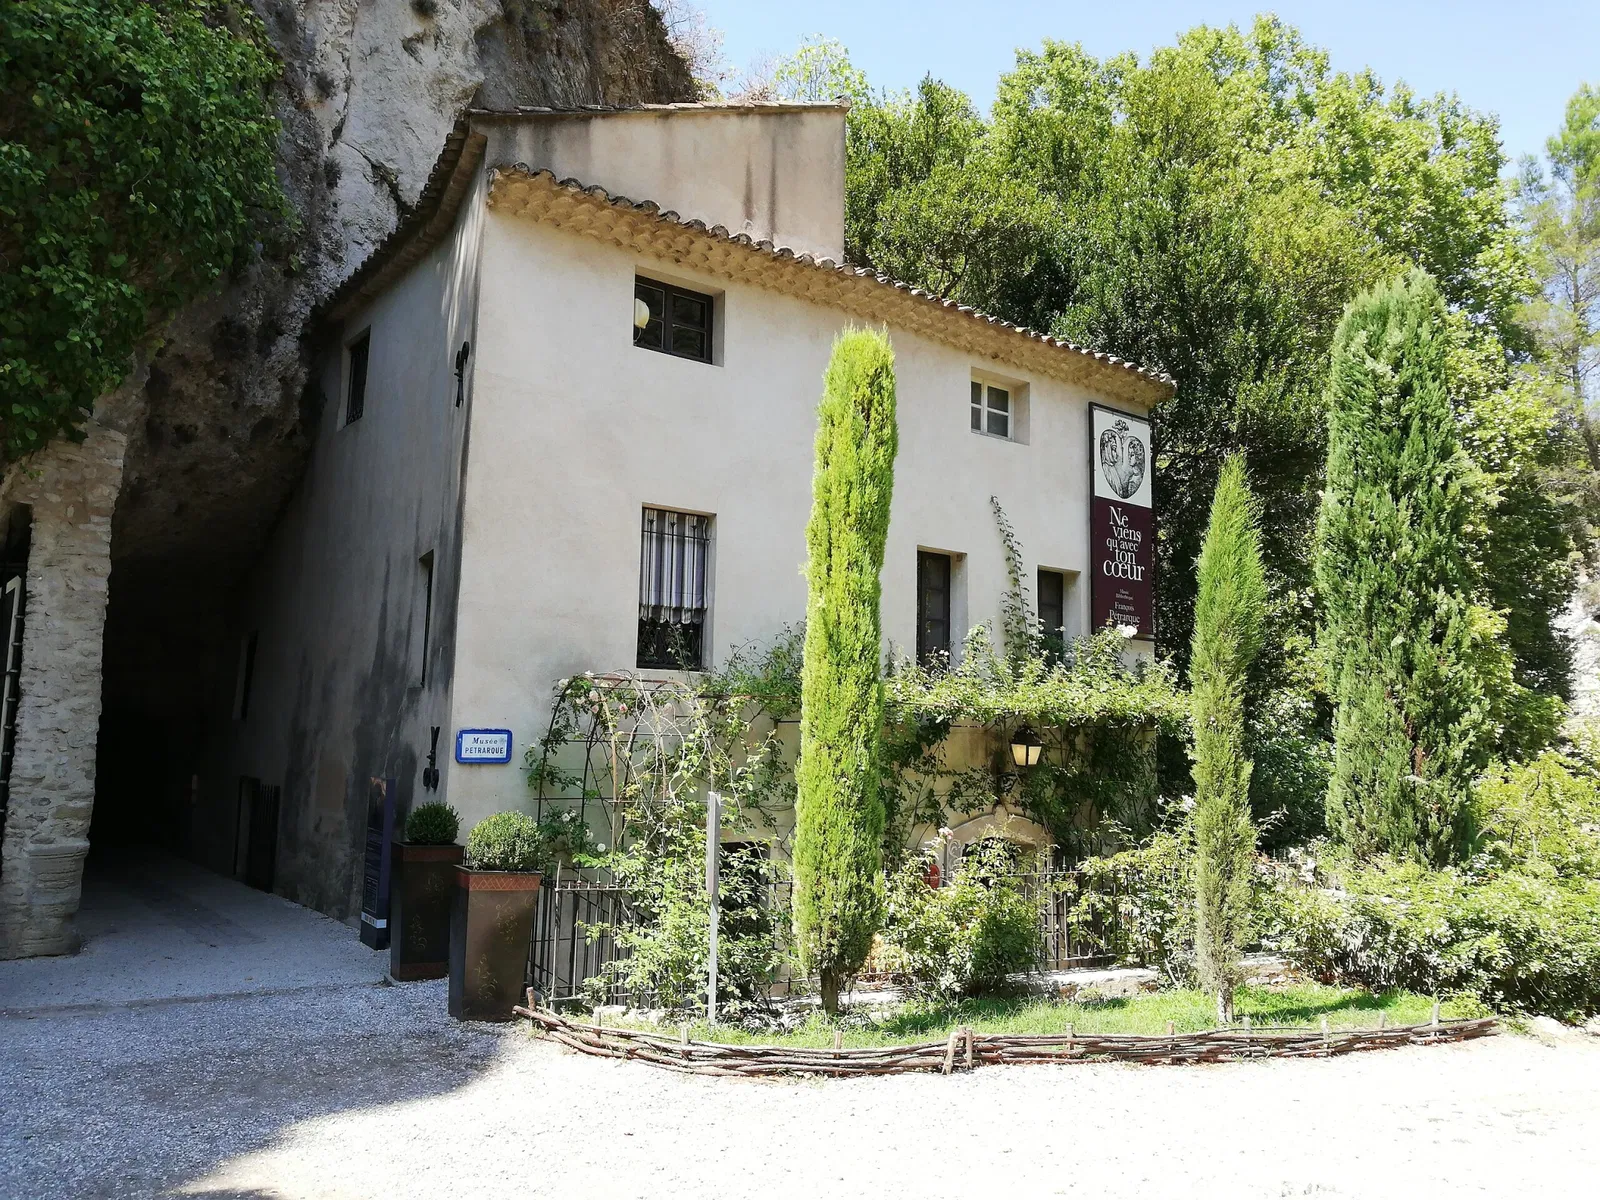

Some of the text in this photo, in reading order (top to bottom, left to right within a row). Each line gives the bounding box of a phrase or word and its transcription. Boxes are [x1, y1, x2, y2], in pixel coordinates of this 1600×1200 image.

[1109, 505, 1129, 528] Ne
[1112, 526, 1141, 543] viens
[1106, 537, 1139, 552] qu'avec
[1115, 548, 1136, 565] ton
[472, 737, 498, 745] Musée
